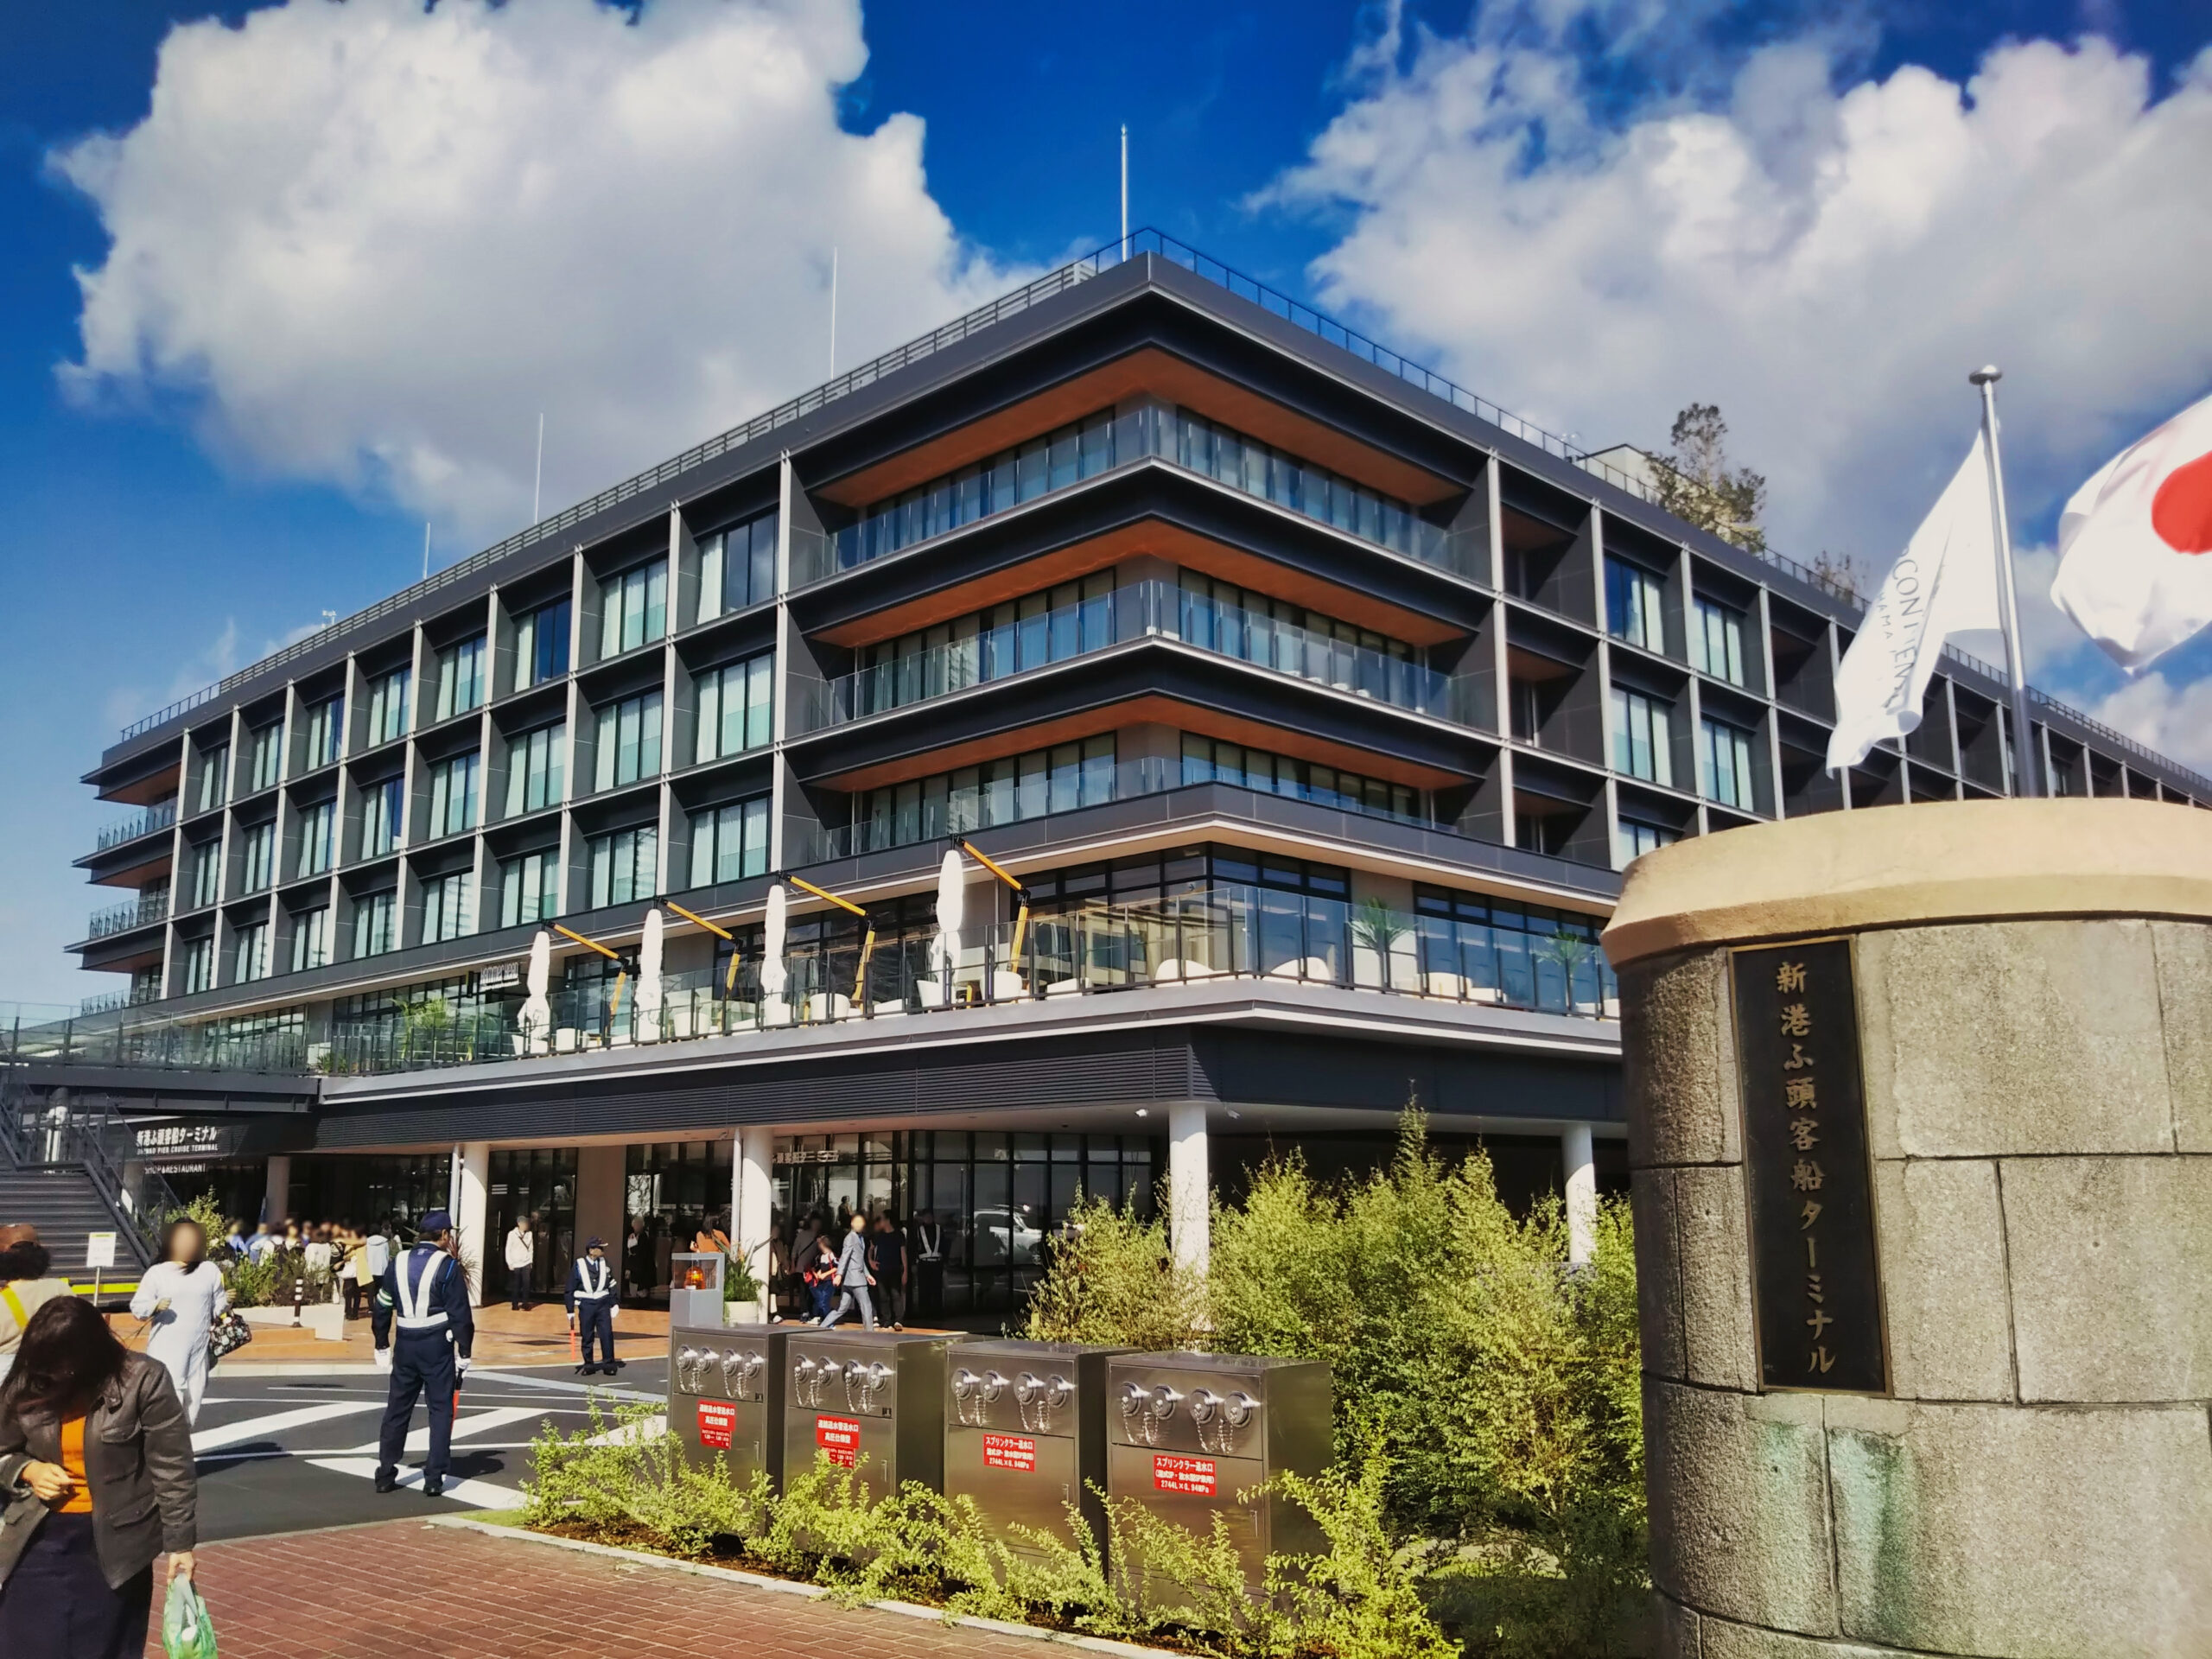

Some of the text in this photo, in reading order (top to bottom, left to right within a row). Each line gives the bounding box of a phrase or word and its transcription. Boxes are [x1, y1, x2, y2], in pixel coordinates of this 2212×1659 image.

[137, 1126, 217, 1147] 新港ふ頭客船ターミナル
[1776, 961, 1835, 1376] 新港ふ頭客船ターミナル
[1156, 1457, 1213, 1472] スプリンクラー送水口
